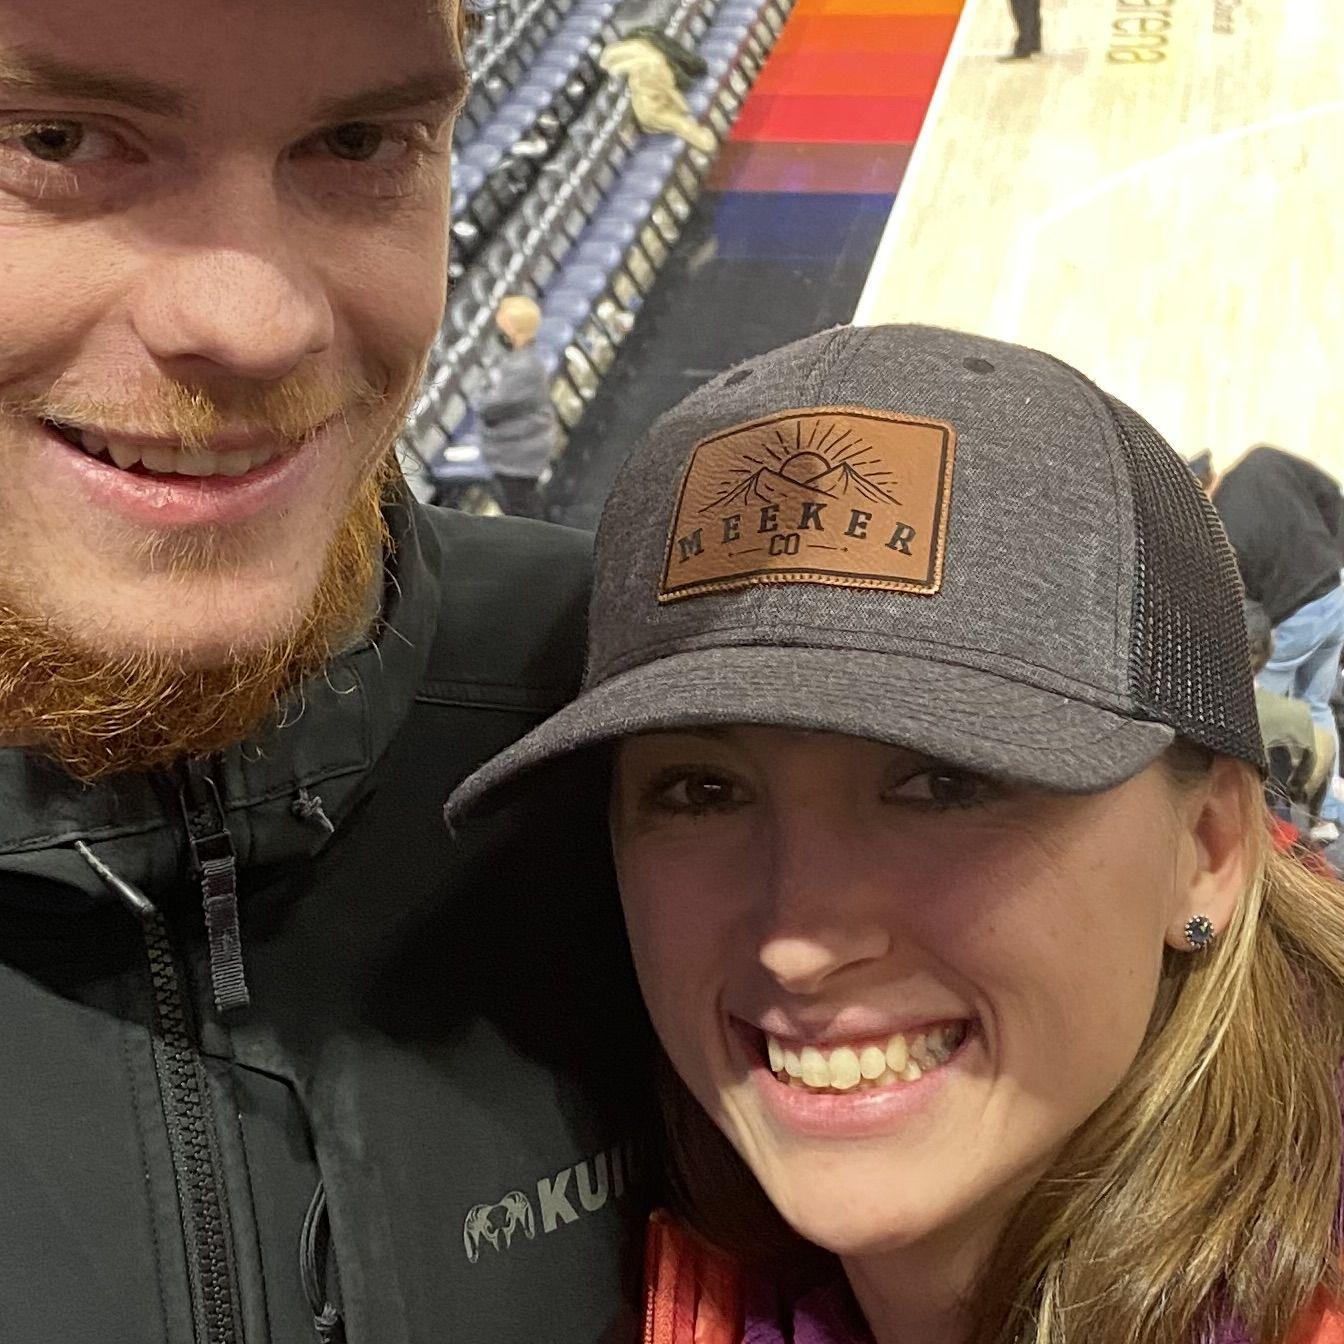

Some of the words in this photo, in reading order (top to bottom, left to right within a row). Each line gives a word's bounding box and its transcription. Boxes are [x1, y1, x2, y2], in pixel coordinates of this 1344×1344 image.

[678, 502, 917, 563] MEEKER
[767, 533, 800, 556] CO
[537, 1147, 628, 1233] KUI
